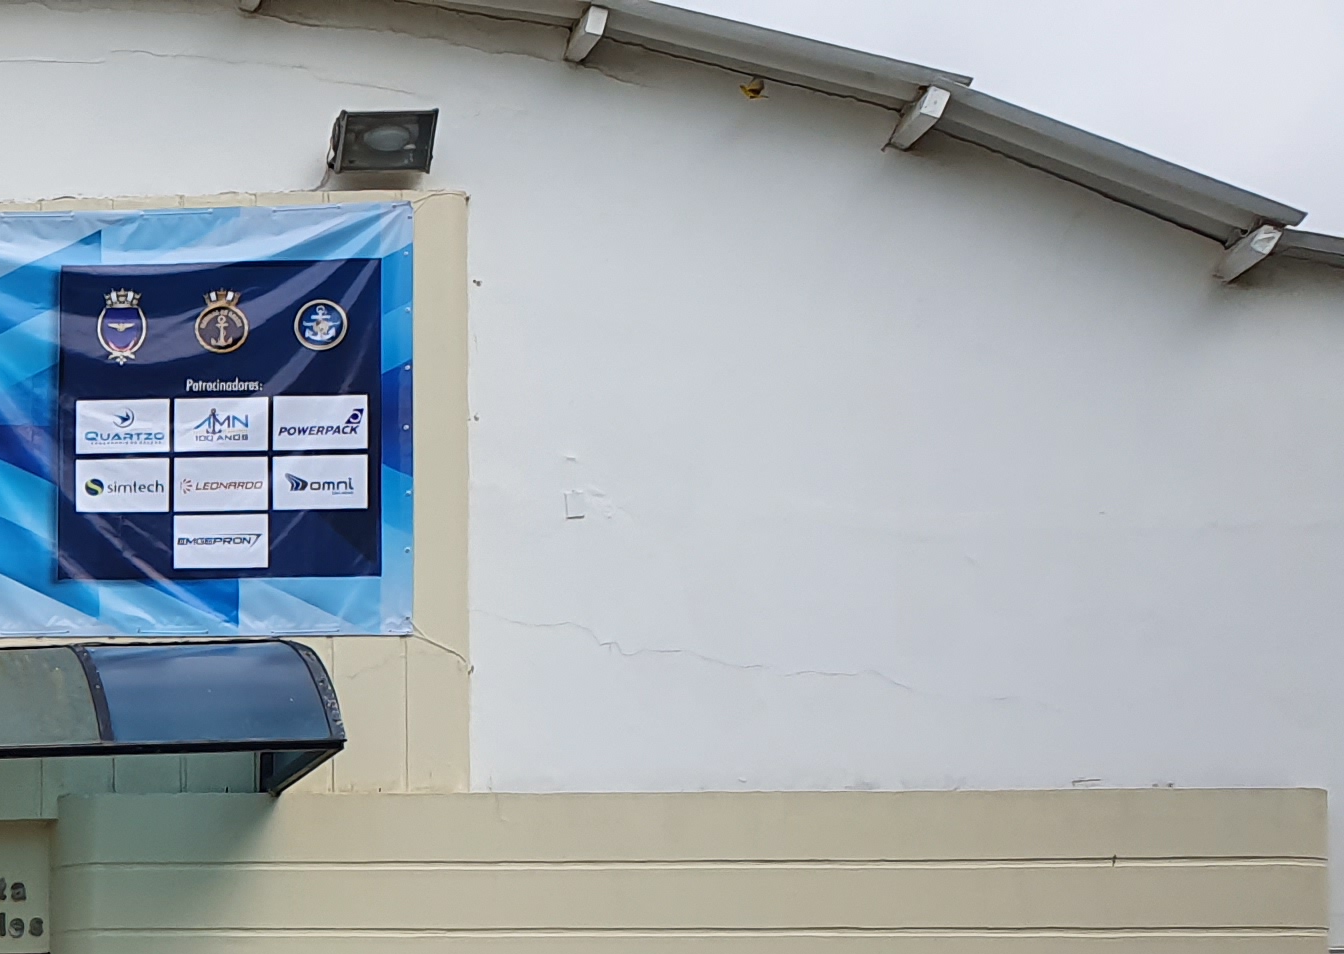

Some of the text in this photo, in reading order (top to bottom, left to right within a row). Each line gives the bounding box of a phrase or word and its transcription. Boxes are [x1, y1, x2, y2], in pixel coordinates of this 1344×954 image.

[185, 377, 263, 392] Patrocinadores:
[84, 431, 165, 441] QUARTZO
[278, 425, 359, 437] POWERPACK
[107, 480, 165, 494] simtech
[195, 481, 264, 491] LEONARDO
[310, 477, 354, 491] omni
